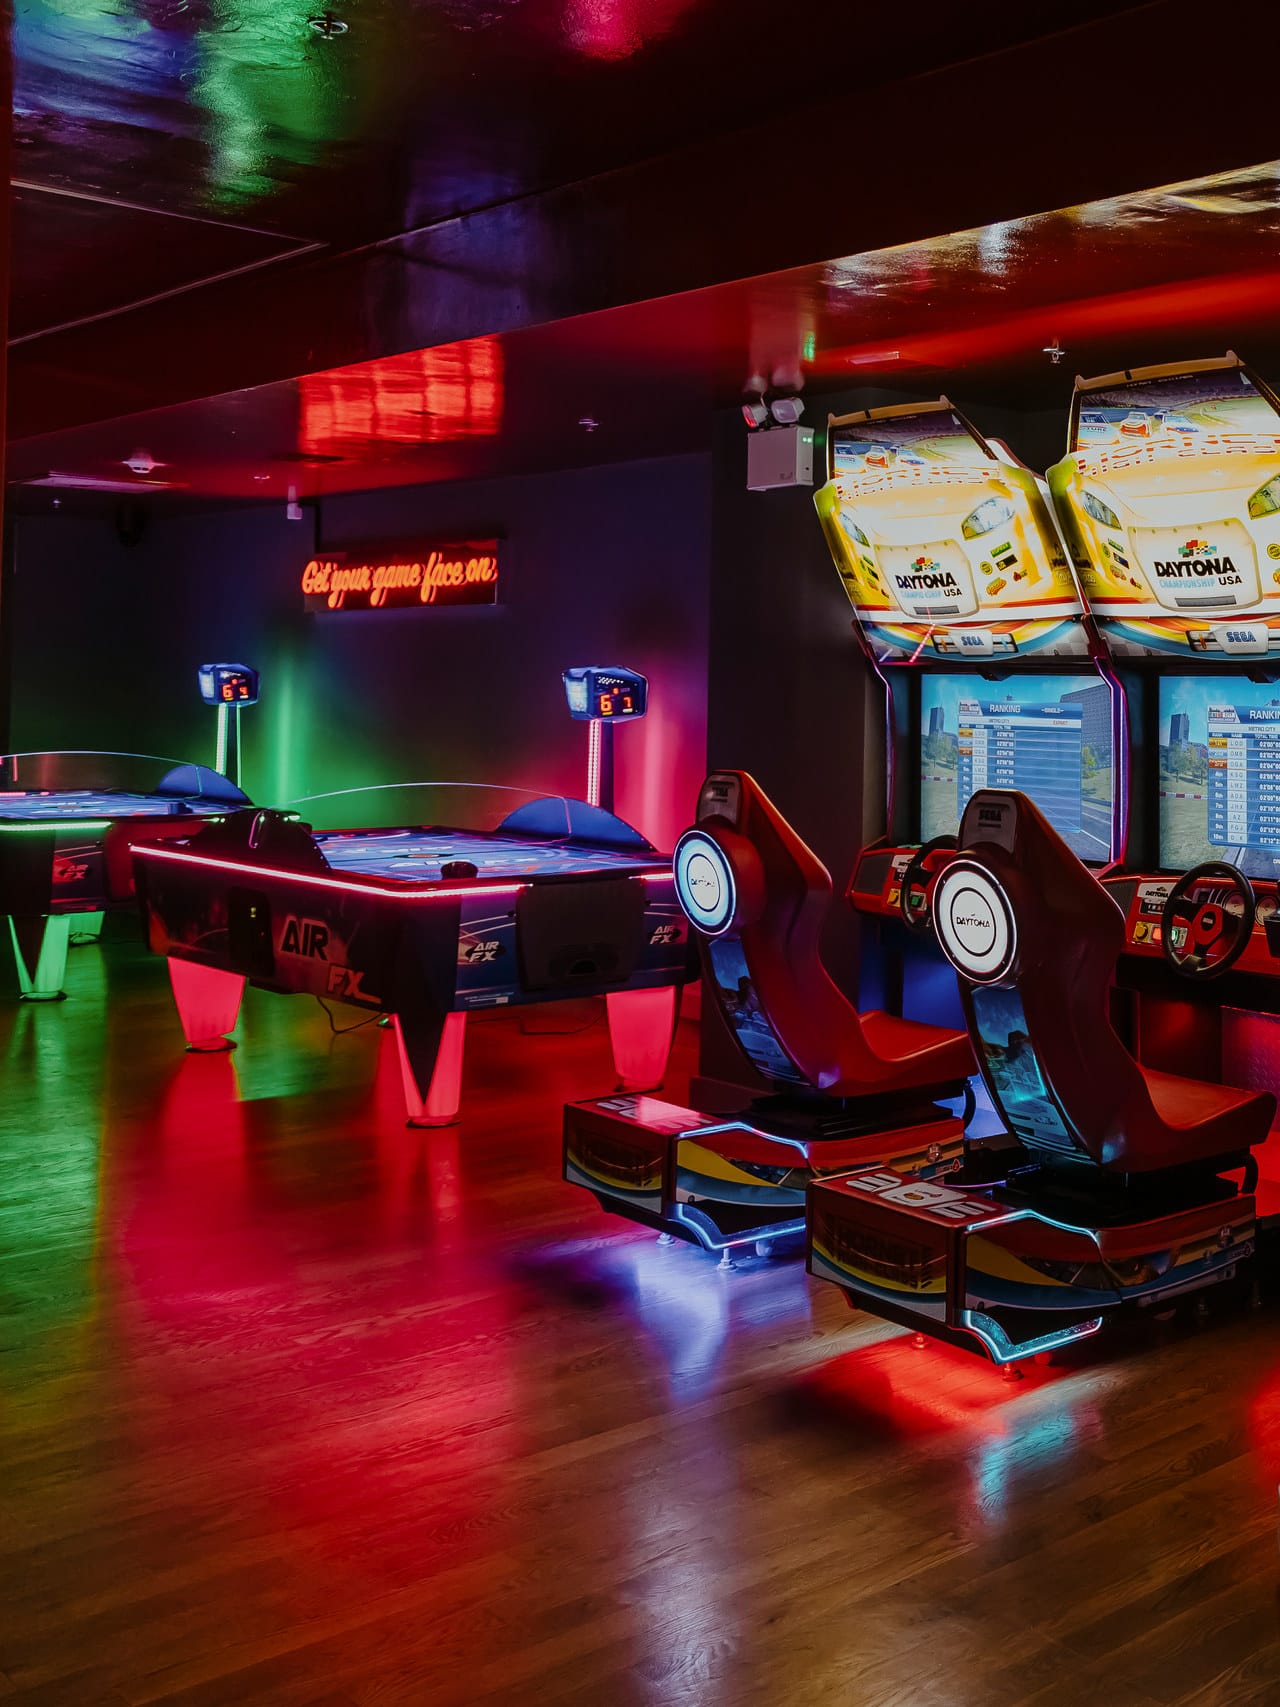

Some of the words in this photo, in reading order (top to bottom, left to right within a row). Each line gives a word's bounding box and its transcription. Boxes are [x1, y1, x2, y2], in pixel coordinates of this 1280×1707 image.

[1153, 556, 1238, 578] DAYTONA
[302, 561, 332, 594] Get
[328, 565, 371, 609] your
[370, 563, 421, 606] game
[420, 551, 464, 603] face
[465, 556, 494, 582] on
[895, 571, 958, 590] DAYTONA
[1218, 575, 1243, 586] USA
[943, 588, 963, 597] USA
[960, 636, 985, 646] SEGA
[1226, 631, 1257, 643] SEGA
[222, 684, 233, 698] 6
[600, 694, 612, 712] 6
[623, 696, 631, 708] 7
[990, 704, 1020, 713] RANKING
[956, 917, 991, 928] DAYTONA
[655, 925, 673, 934] AIR
[280, 916, 330, 961] AIR
[650, 934, 673, 944] FX
[475, 941, 499, 951] AIR
[469, 951, 496, 963] FX
[328, 964, 381, 1004] FX
